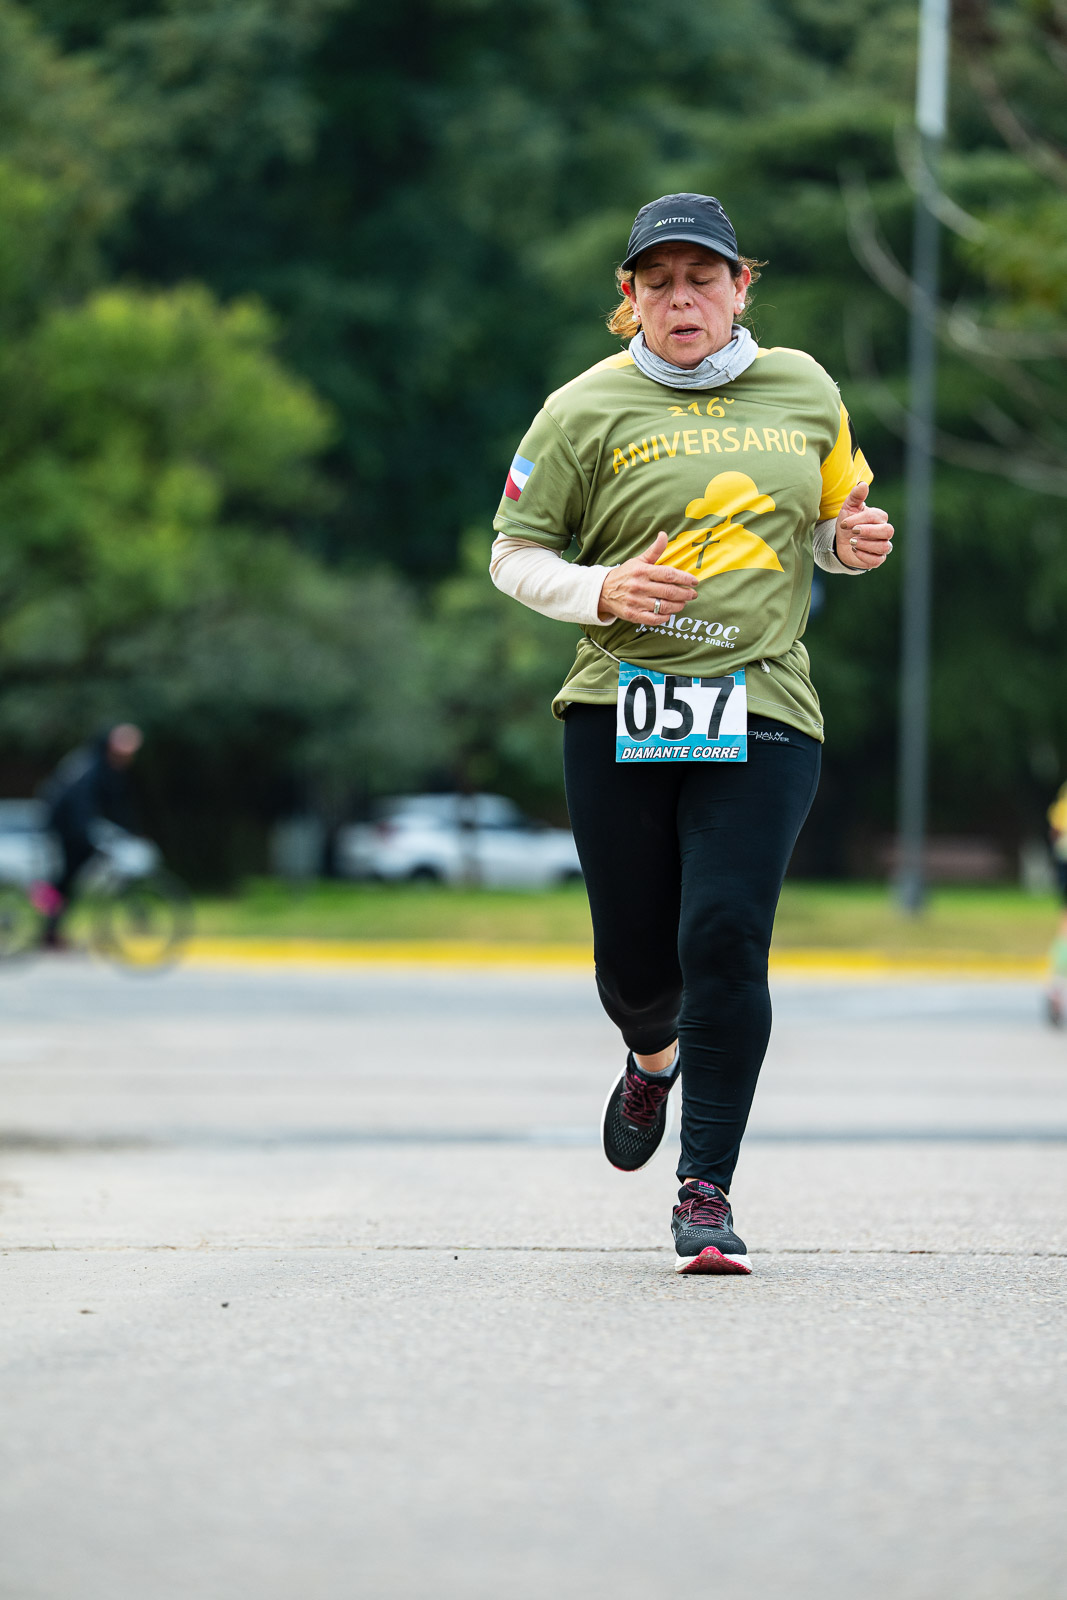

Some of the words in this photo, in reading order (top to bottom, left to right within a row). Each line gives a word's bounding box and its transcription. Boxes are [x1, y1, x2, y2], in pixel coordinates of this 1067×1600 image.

[612, 427, 807, 475] ANIVERSARIO
[705, 637, 735, 649] snacks
[624, 675, 735, 742] 057
[621, 746, 690, 759] DIAMANTE
[692, 746, 740, 759] CORRE
[698, 1181, 715, 1190] FILA
